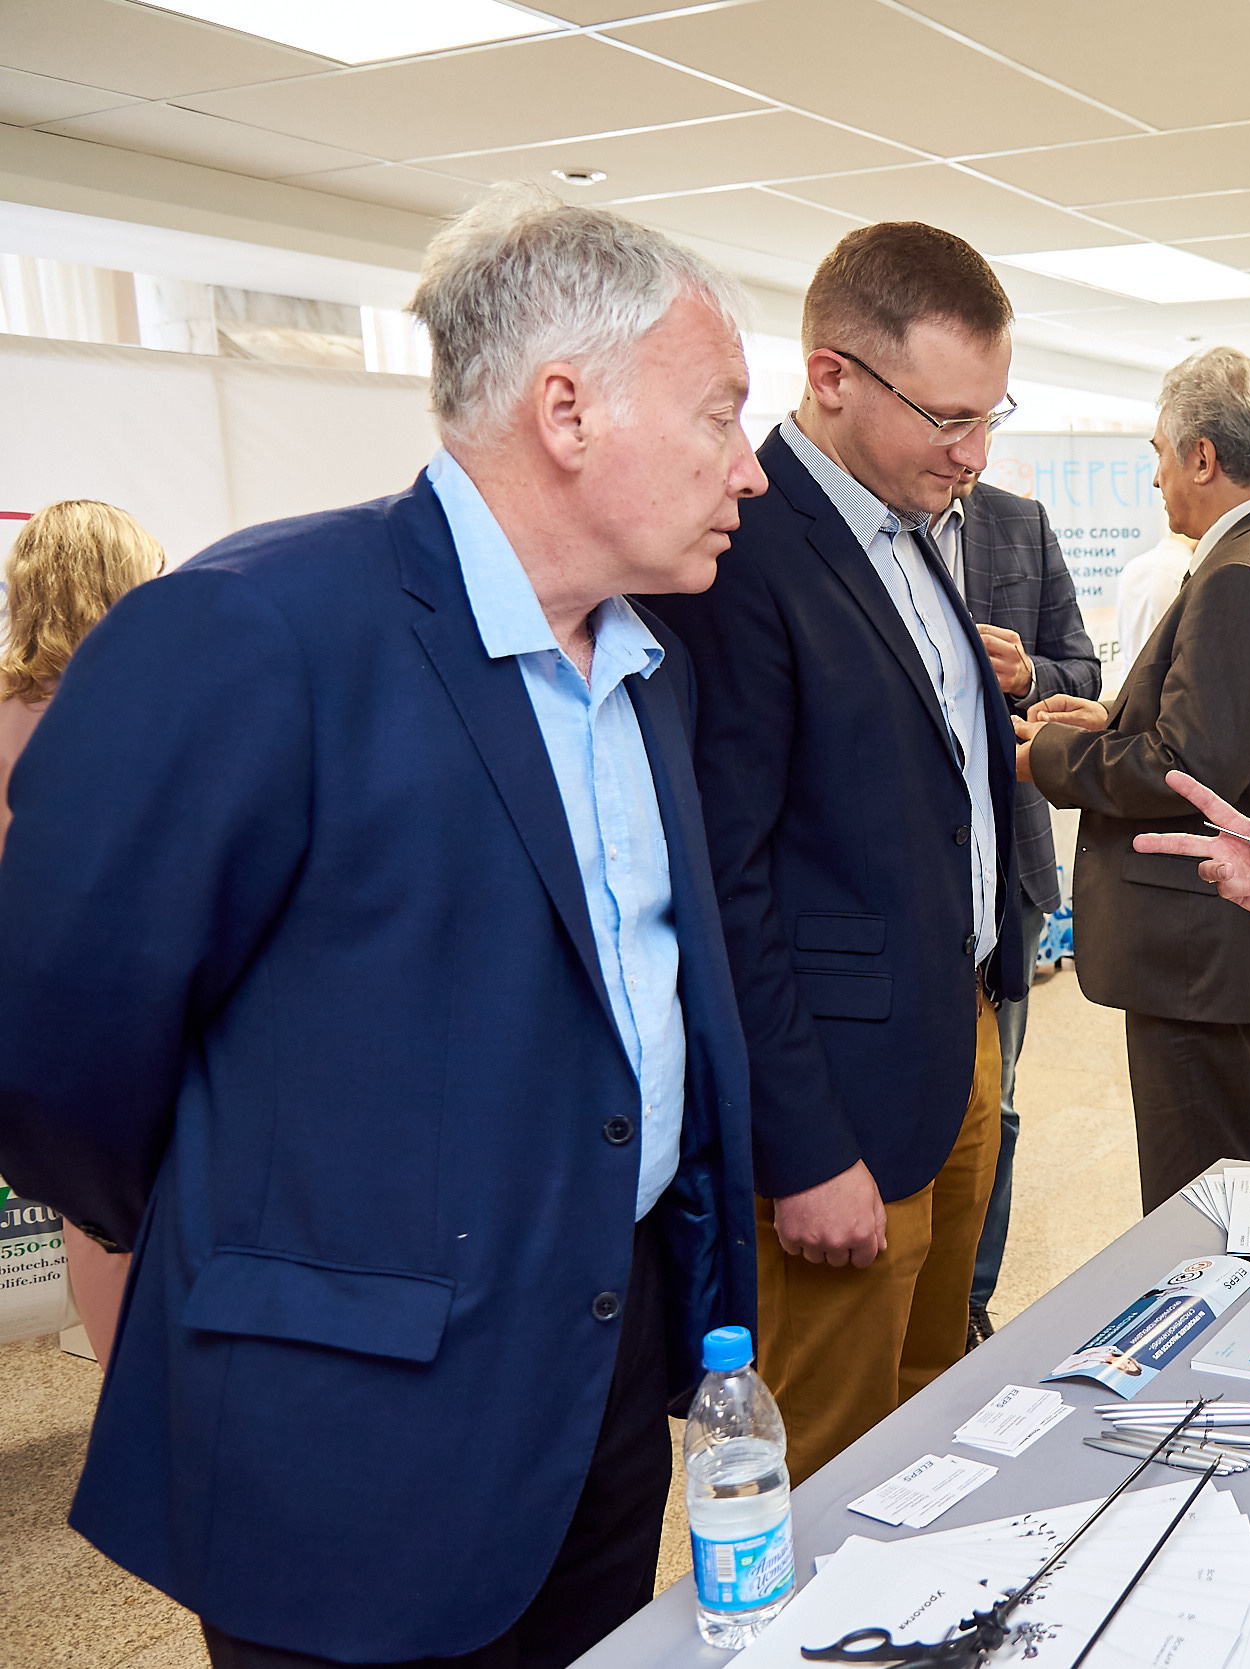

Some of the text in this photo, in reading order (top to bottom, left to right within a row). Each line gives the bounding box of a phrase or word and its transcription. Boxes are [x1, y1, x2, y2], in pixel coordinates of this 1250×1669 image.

[1035, 455, 1153, 507] НЕРЕЙ
[1090, 528, 1141, 539] слово
[1, 1238, 65, 1259] 550-0
[1223, 1267, 1248, 1290] ELEPS
[996, 1388, 1019, 1408] ELEPS
[903, 1460, 934, 1482] ELEPS
[898, 1589, 946, 1630] Урология
